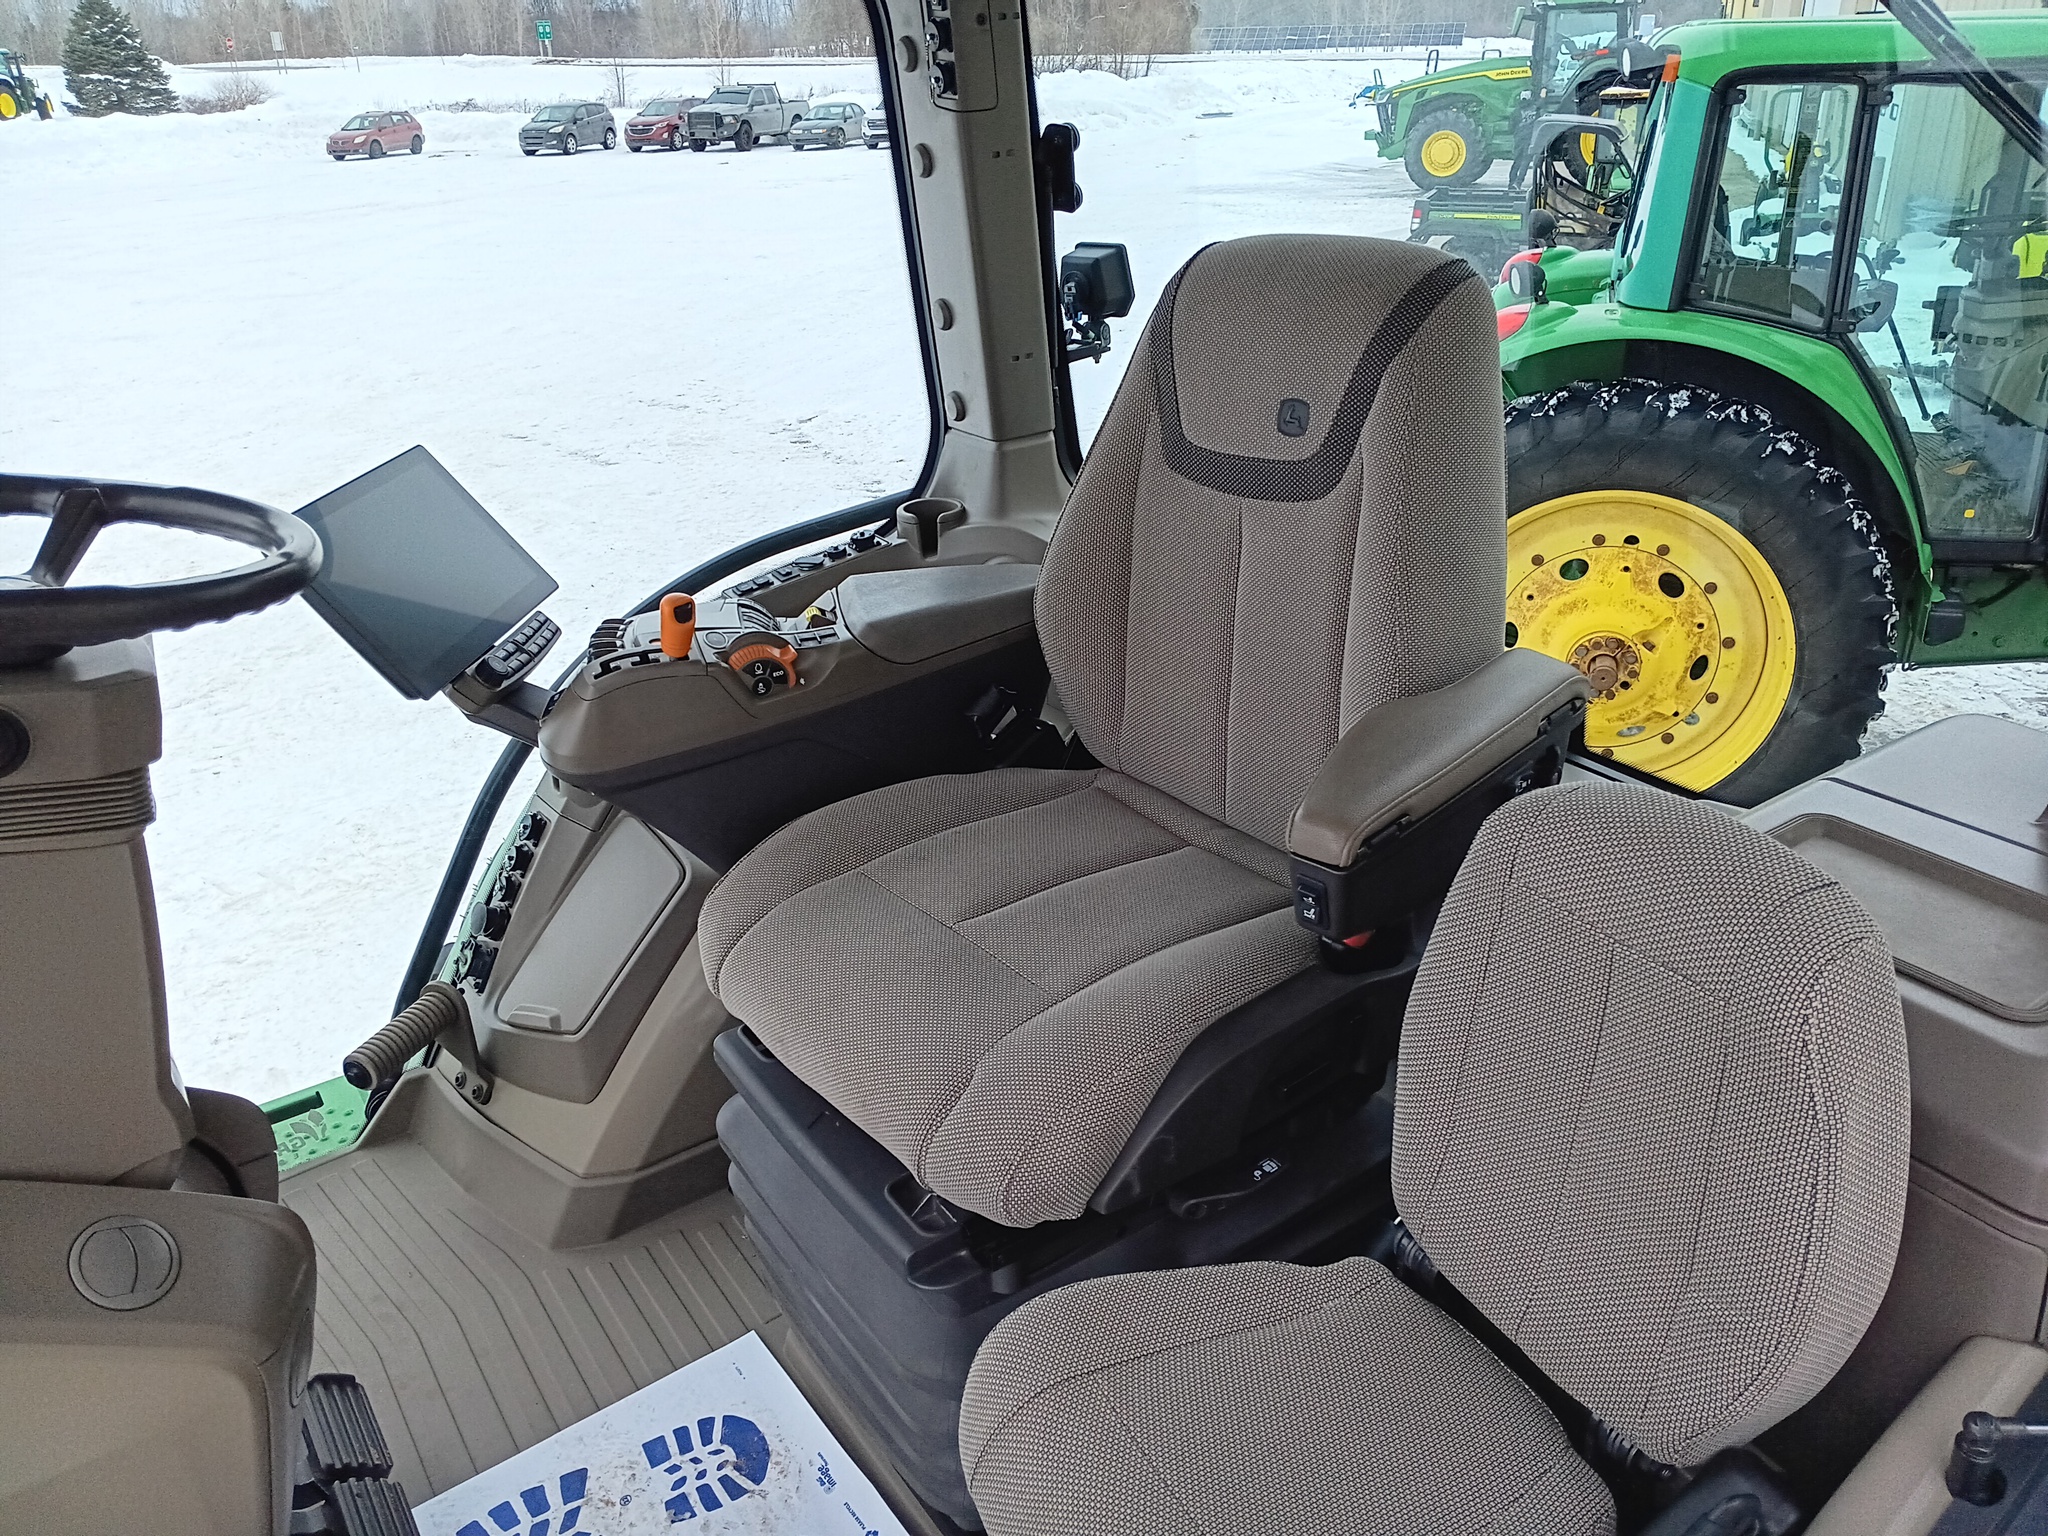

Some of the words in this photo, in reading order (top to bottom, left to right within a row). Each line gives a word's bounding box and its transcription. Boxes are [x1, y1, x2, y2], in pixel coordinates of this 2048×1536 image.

[817, 1464, 837, 1487] image
[843, 1501, 856, 1518] RECYCLE
[855, 1516, 866, 1530] PLEASE
